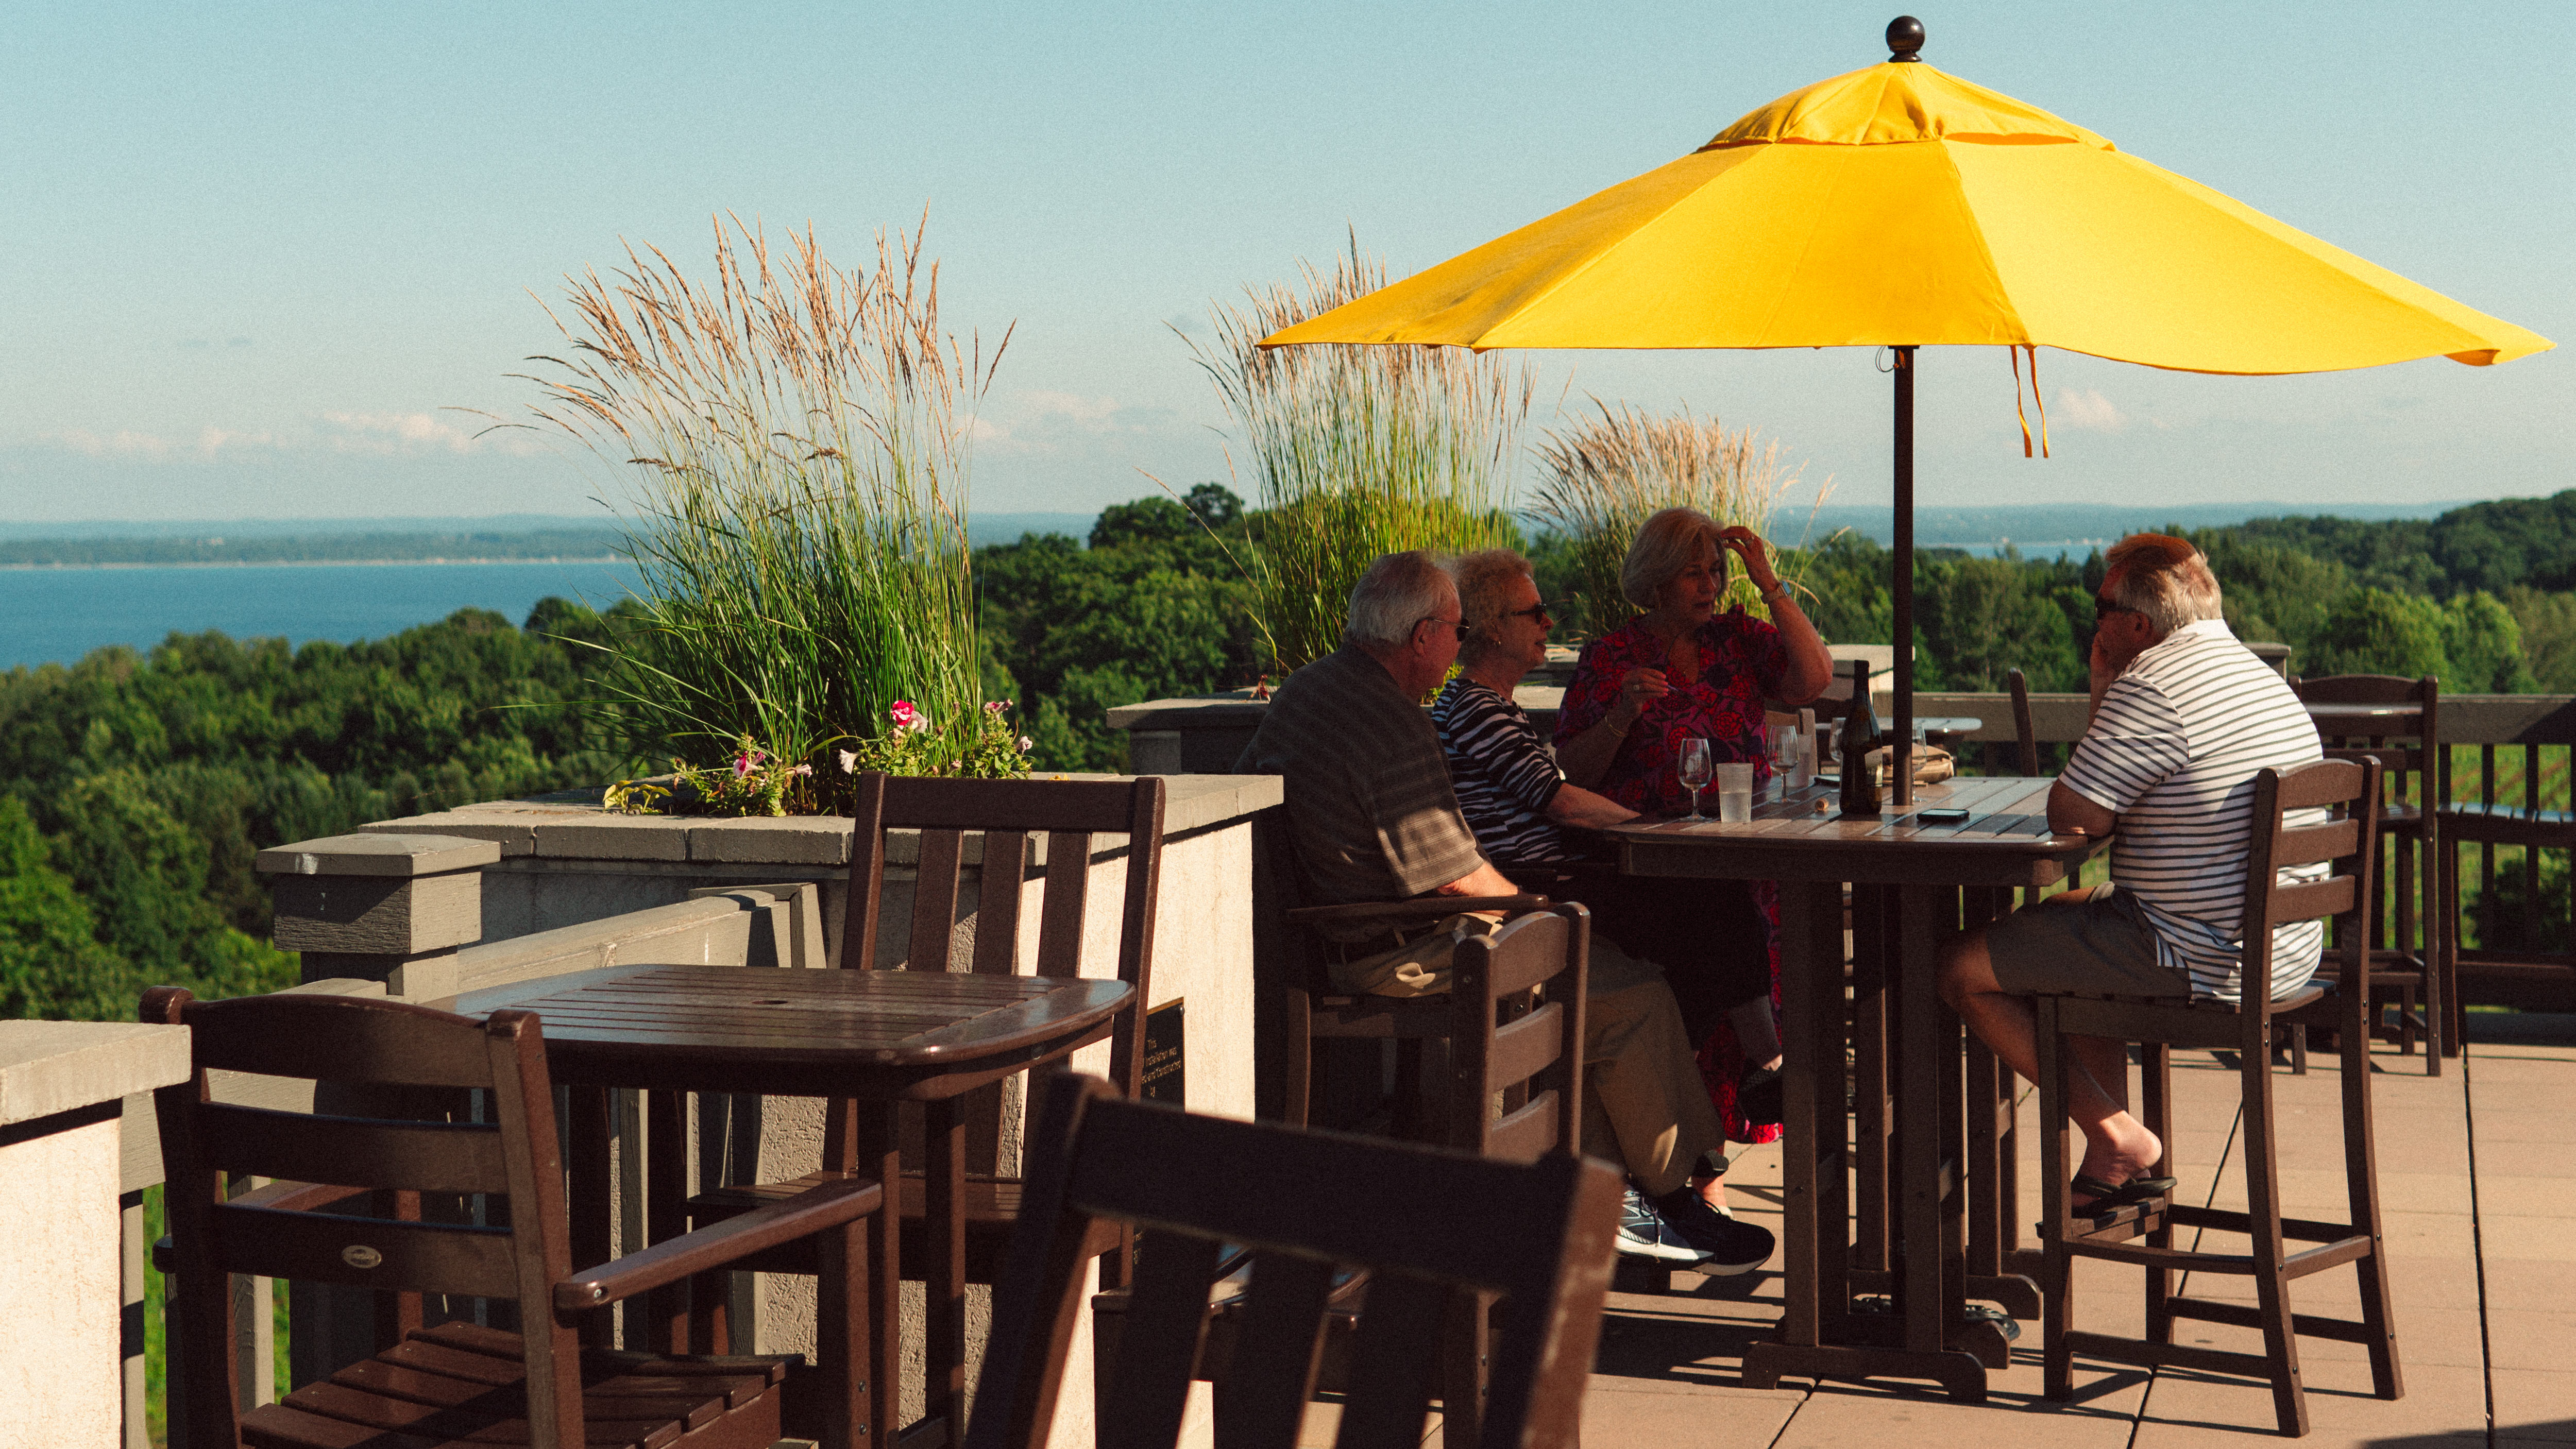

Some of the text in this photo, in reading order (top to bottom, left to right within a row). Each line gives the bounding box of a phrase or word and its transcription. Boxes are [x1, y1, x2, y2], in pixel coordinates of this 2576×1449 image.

[1147, 1037, 1157, 1050] This
[1145, 1049, 1168, 1067] Installation
[1168, 1046, 1177, 1057] was
[1147, 1068, 1156, 1082] and
[1156, 1058, 1181, 1078] Constructed
[1149, 1085, 1156, 1098] by
